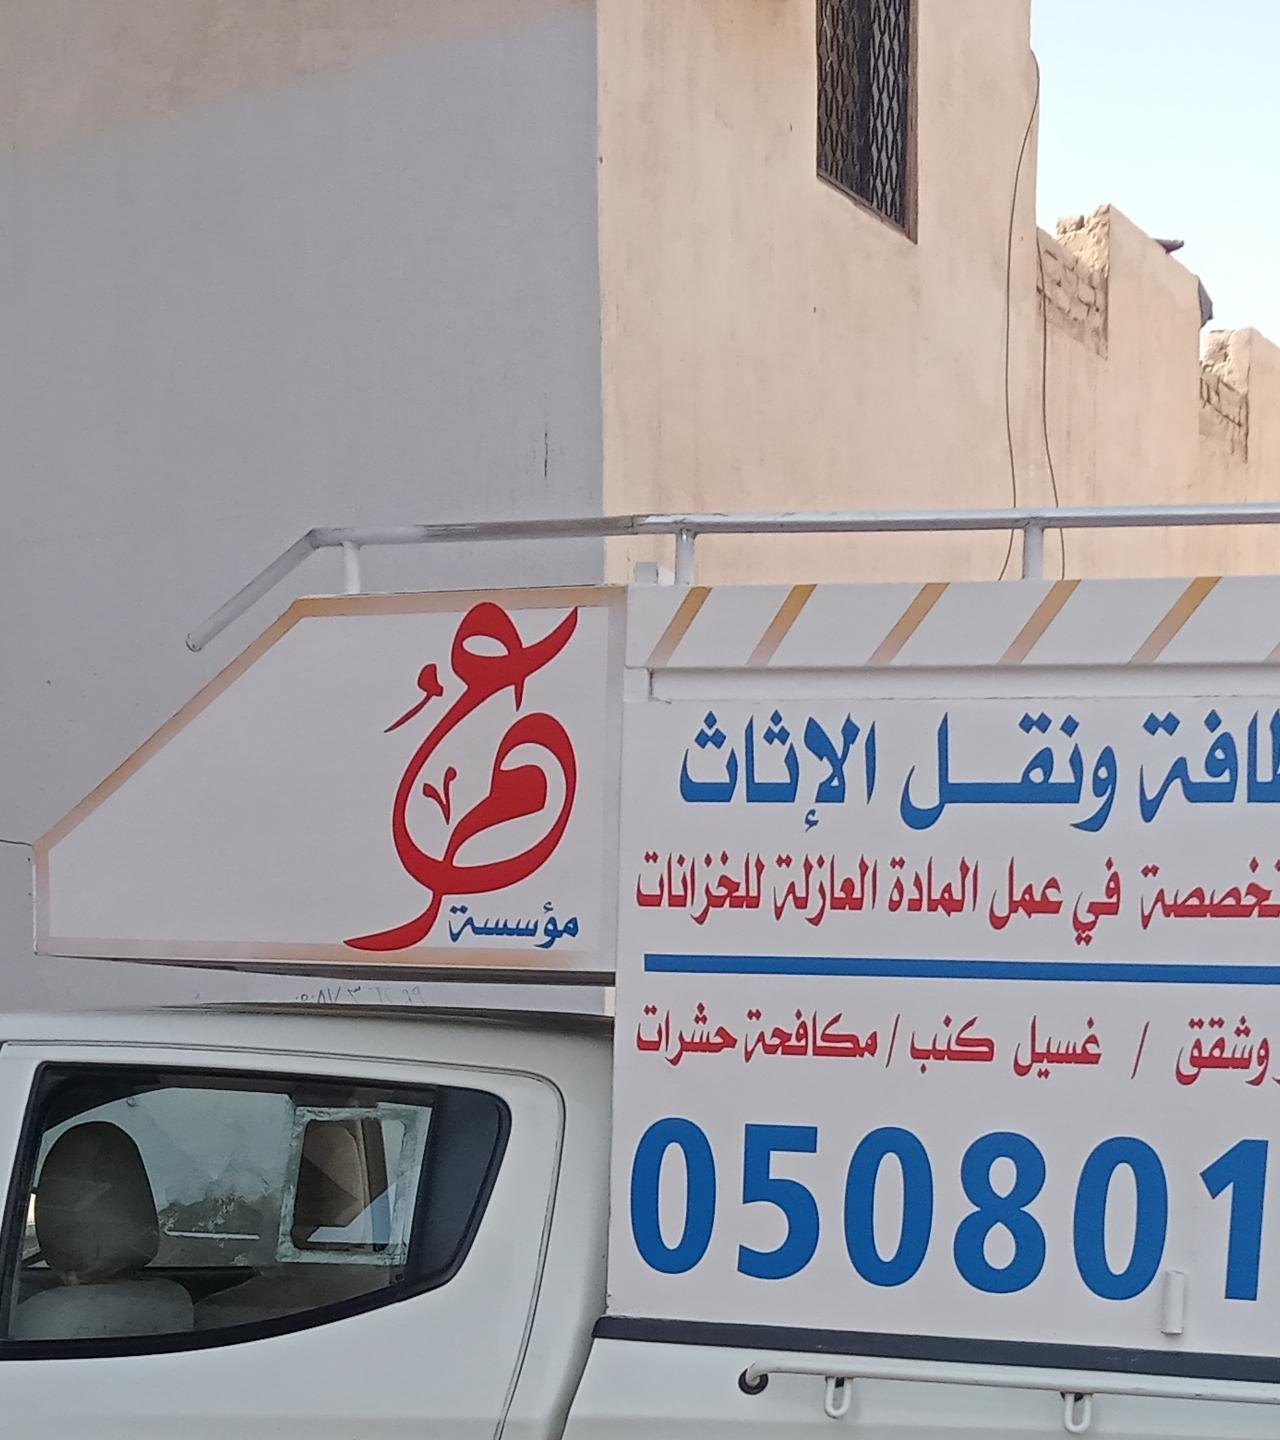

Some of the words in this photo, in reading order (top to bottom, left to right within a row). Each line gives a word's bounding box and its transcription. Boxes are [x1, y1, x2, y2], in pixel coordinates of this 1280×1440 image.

[678, 710, 877, 832] الإثاث
[900, 711, 1119, 833] ونقل
[635, 850, 766, 924] للخزانات
[773, 853, 878, 927] العازلة
[887, 854, 980, 918] المادة
[987, 856, 1064, 931] عمل
[1071, 856, 1122, 946] في
[448, 900, 580, 949] مؤسسة
[635, 1002, 738, 1068] حشرات
[742, 1008, 879, 1064] مكافحة
[909, 1014, 995, 1074] كنب
[1012, 1014, 1103, 1080] غسيل
[1174, 1015, 1270, 1087] وشقق
